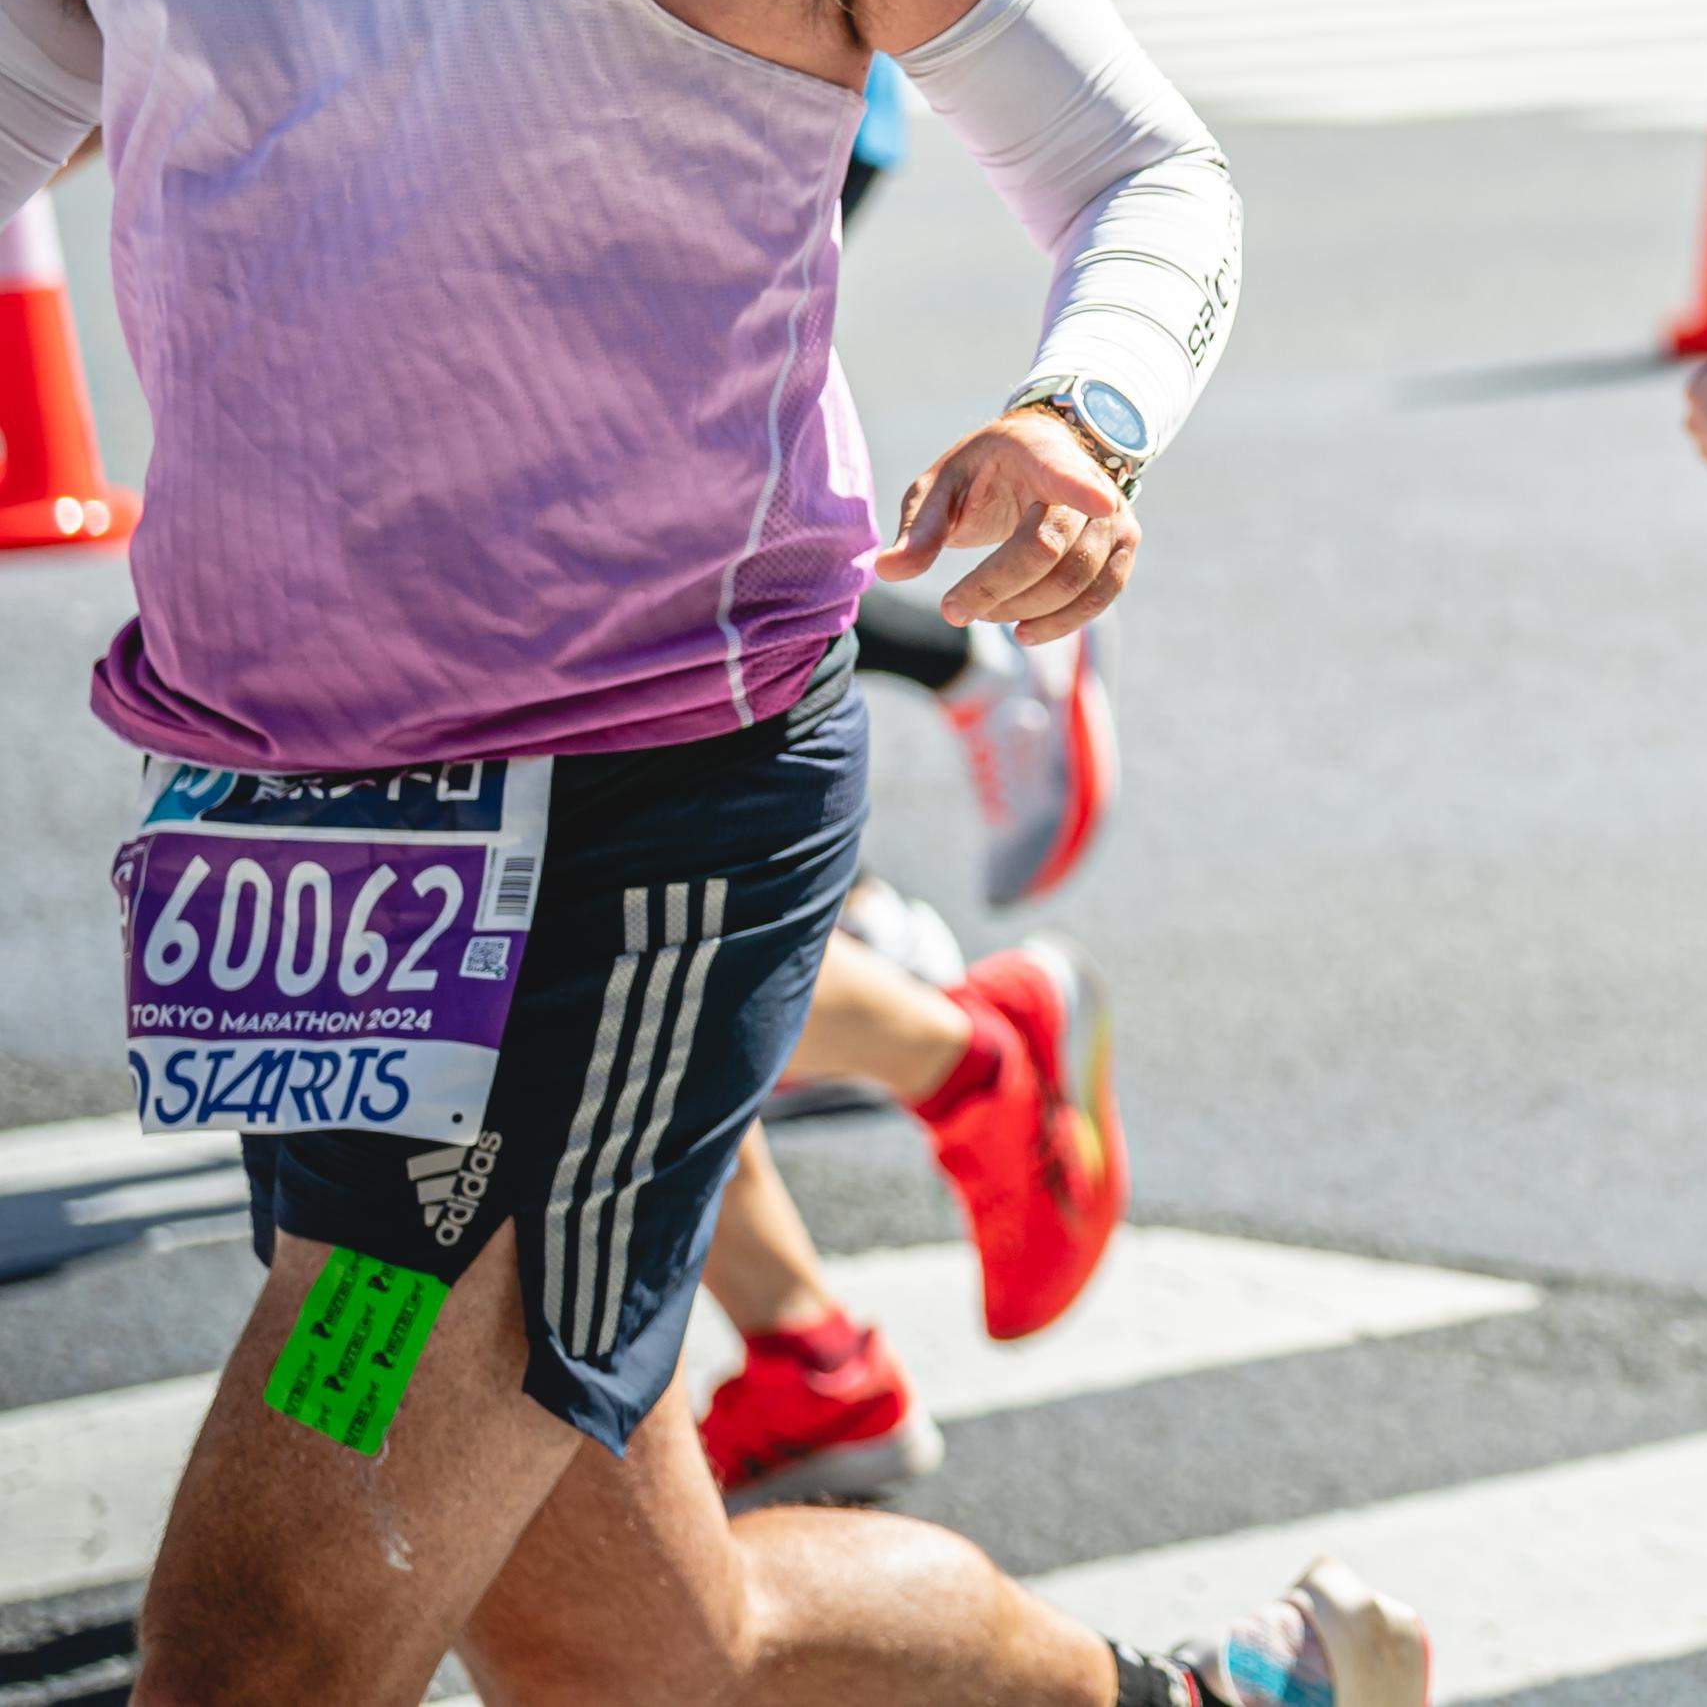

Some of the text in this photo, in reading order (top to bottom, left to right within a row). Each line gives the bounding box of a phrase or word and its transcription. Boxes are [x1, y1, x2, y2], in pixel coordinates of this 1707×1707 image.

[143, 855, 463, 997] 60062
[131, 1003, 433, 1033] TOKYO MARATHON 2024
[154, 1048, 411, 1125] STARTS
[435, 1130, 501, 1248] adidas
